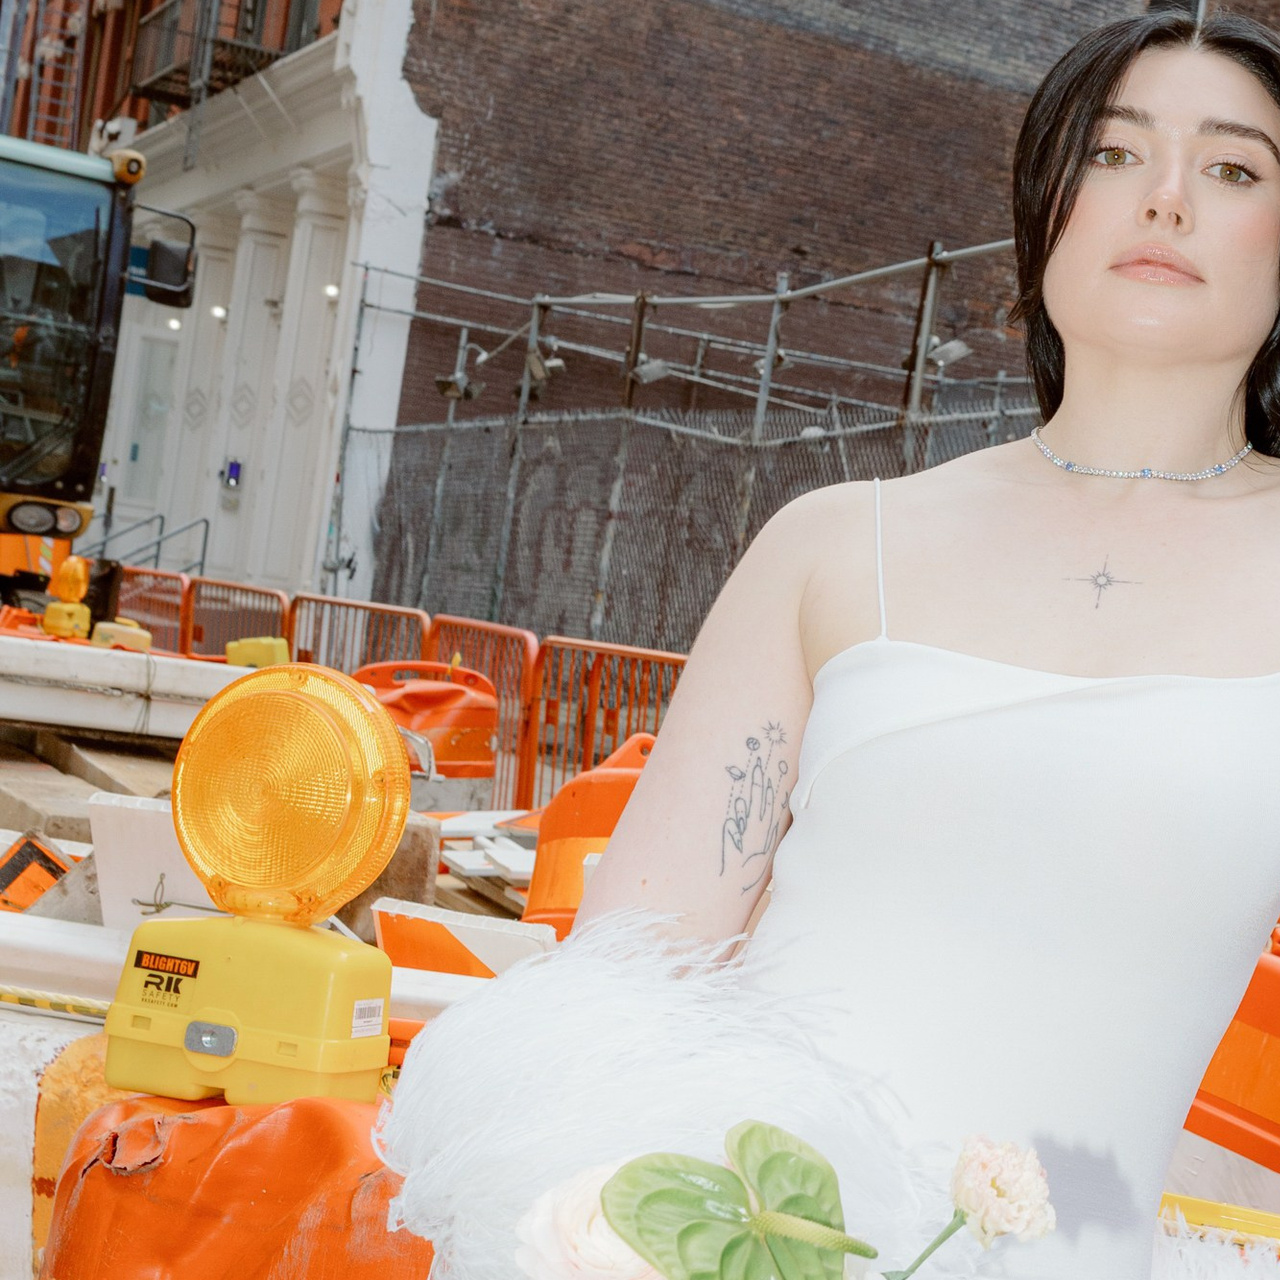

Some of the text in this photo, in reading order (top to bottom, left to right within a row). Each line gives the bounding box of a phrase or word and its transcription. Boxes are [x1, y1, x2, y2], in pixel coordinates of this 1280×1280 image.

[141, 953, 197, 976] BLIGHT6V
[144, 973, 184, 995] RK
[142, 989, 181, 1003] SAFETY
